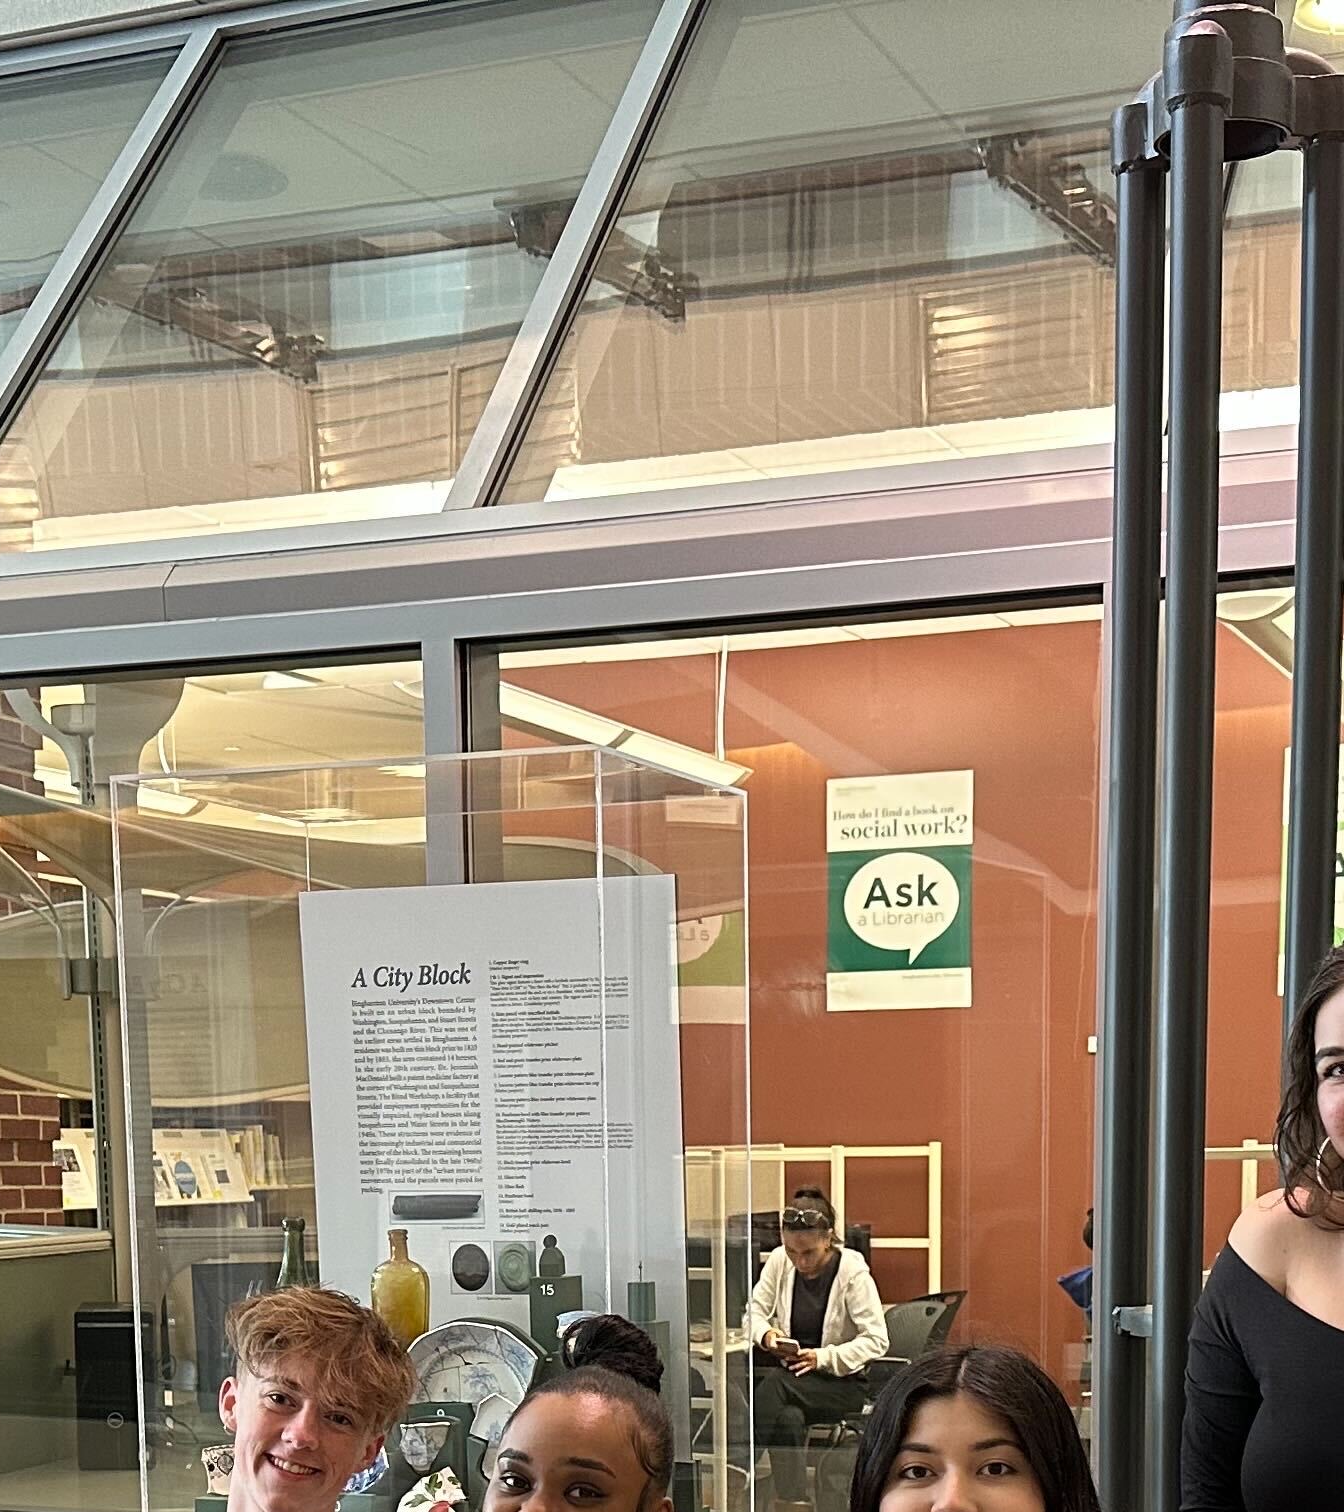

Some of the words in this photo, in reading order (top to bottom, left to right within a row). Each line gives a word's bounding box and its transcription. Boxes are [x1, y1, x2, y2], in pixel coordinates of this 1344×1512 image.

[834, 811, 856, 820] How
[859, 809, 872, 819] do
[875, 810, 879, 818] I
[882, 807, 902, 817] find
[913, 805, 937, 815] book
[840, 819, 897, 840] social
[904, 815, 968, 837] work?
[863, 874, 939, 909] Ask
[857, 915, 867, 927] a
[873, 911, 944, 926] Librarian
[351, 966, 366, 988] A
[373, 966, 413, 992] City
[417, 963, 471, 986] Block
[540, 1284, 554, 1296] 15
